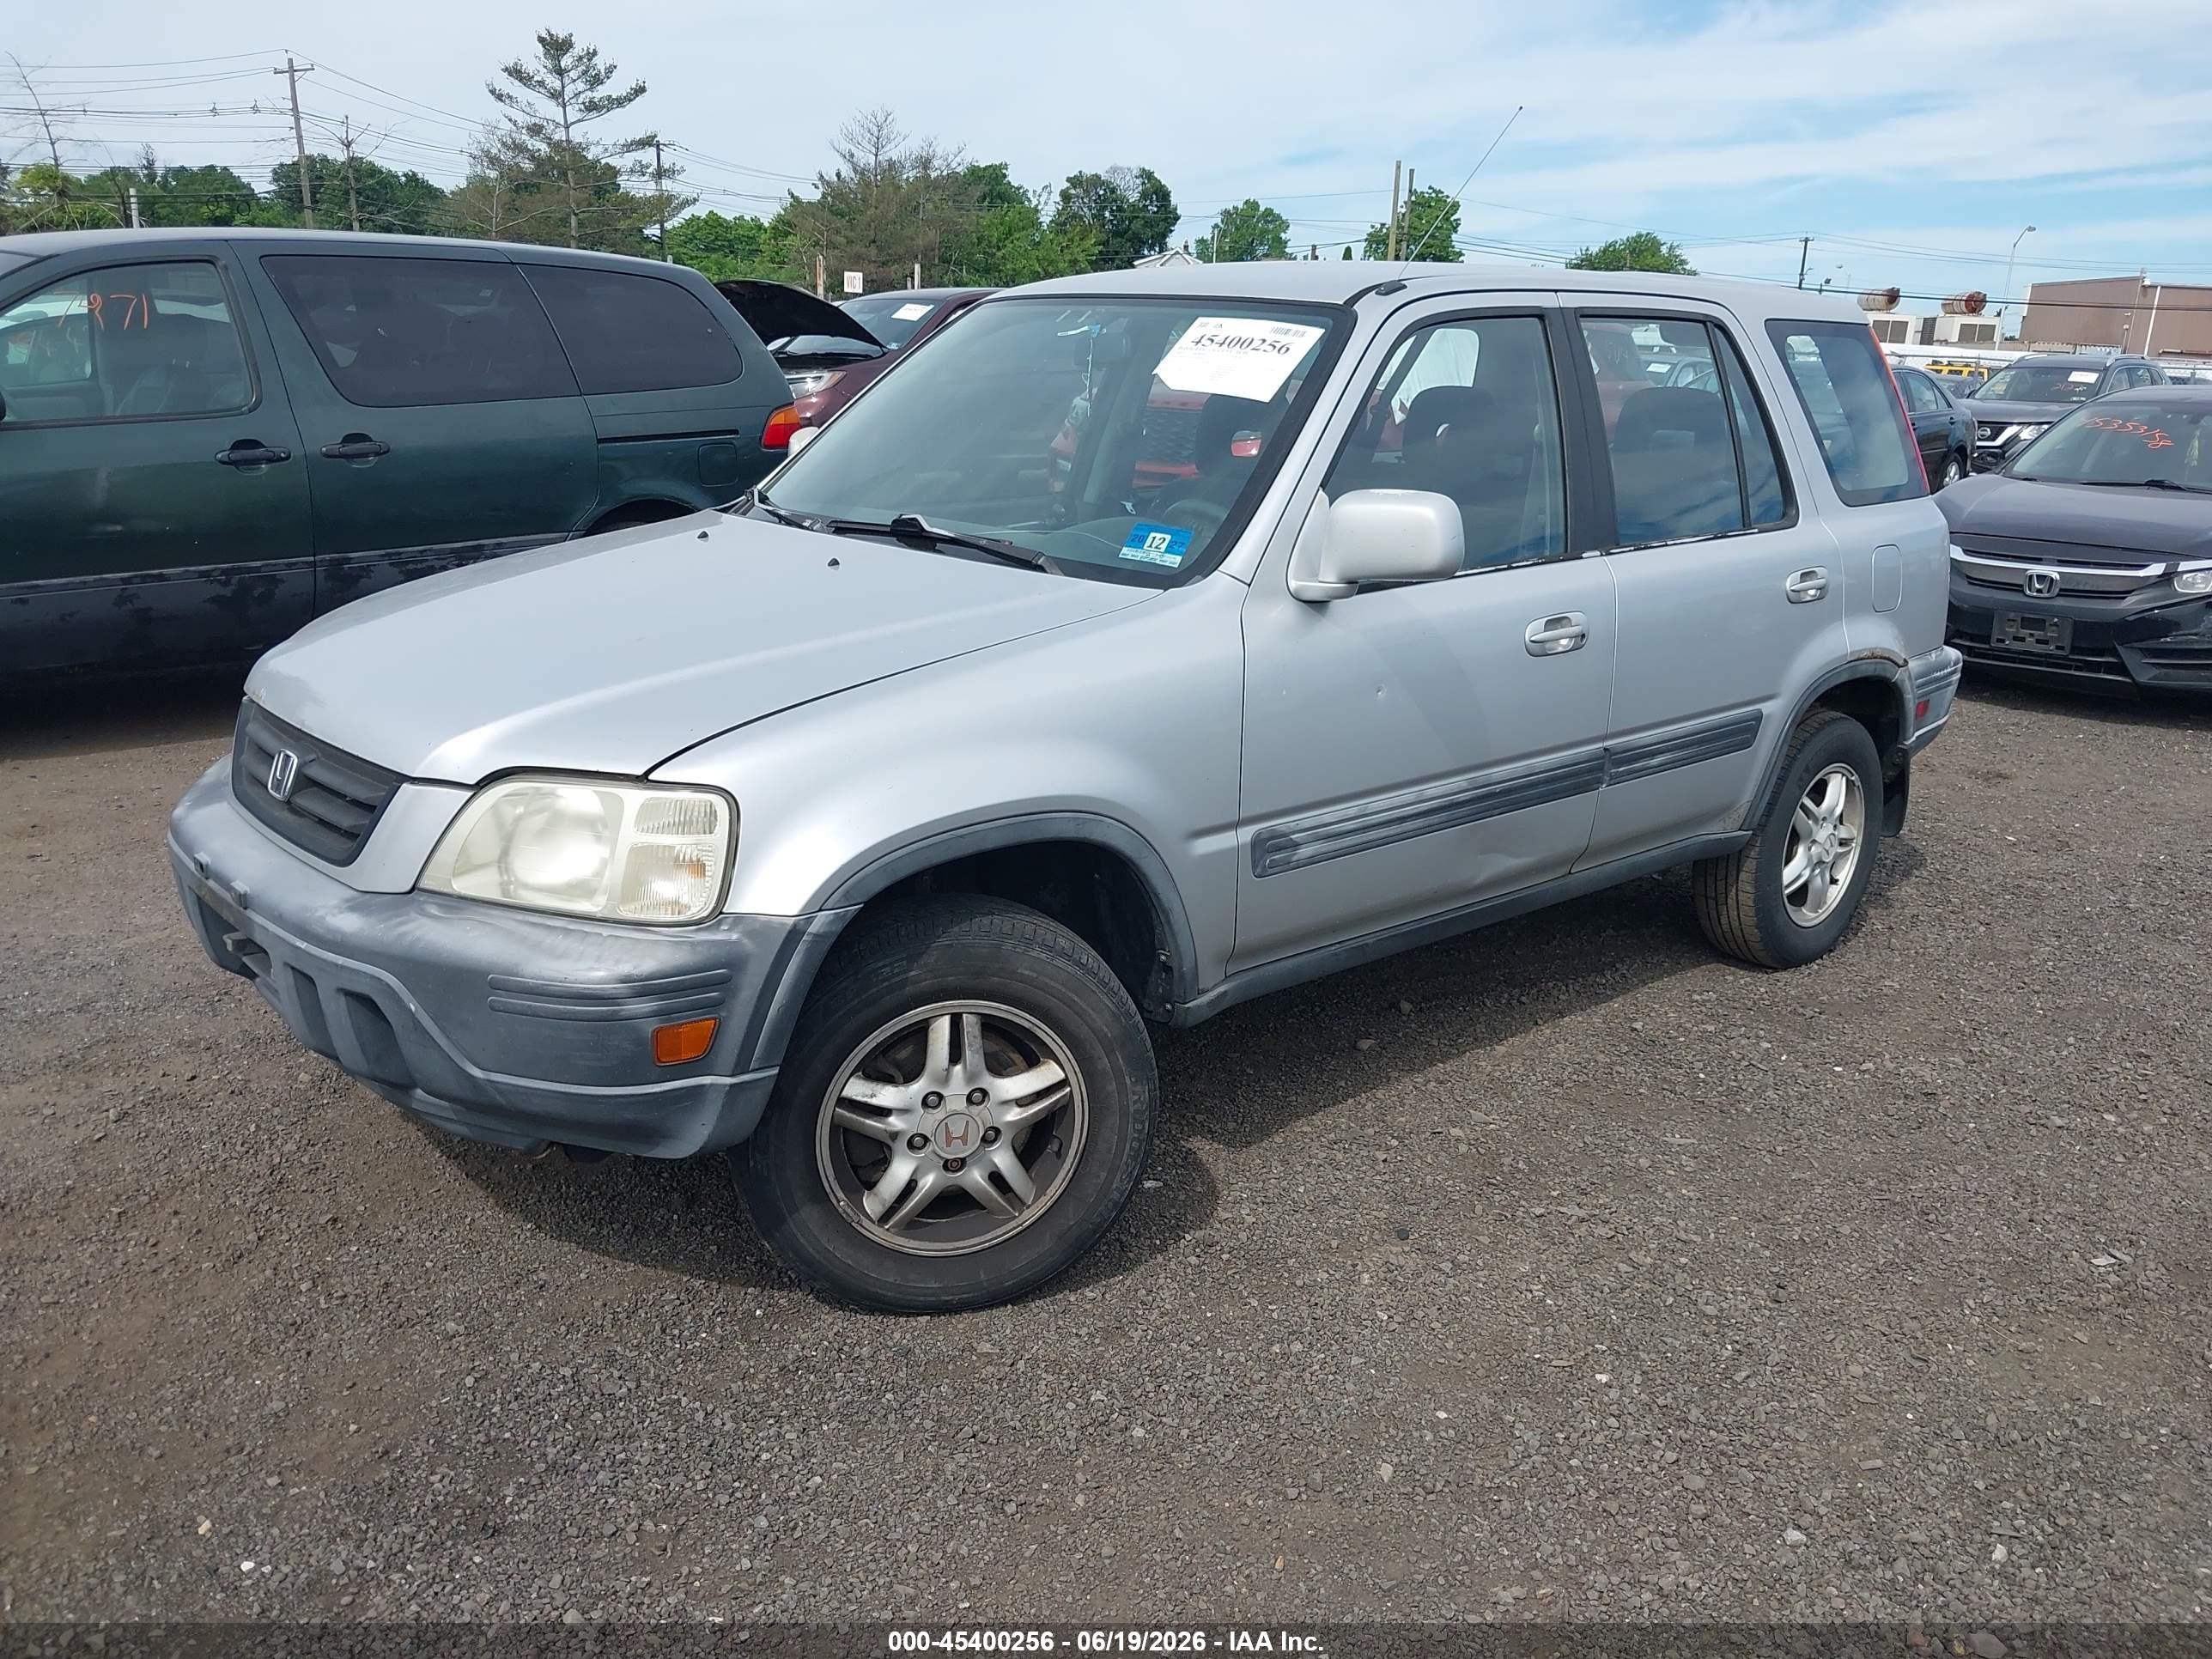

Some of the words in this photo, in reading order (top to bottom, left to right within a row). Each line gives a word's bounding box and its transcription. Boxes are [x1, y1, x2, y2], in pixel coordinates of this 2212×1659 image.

[1190, 333, 1295, 356] 45400256
[1130, 534, 1146, 544] 20
[1146, 535, 1166, 550] 12
